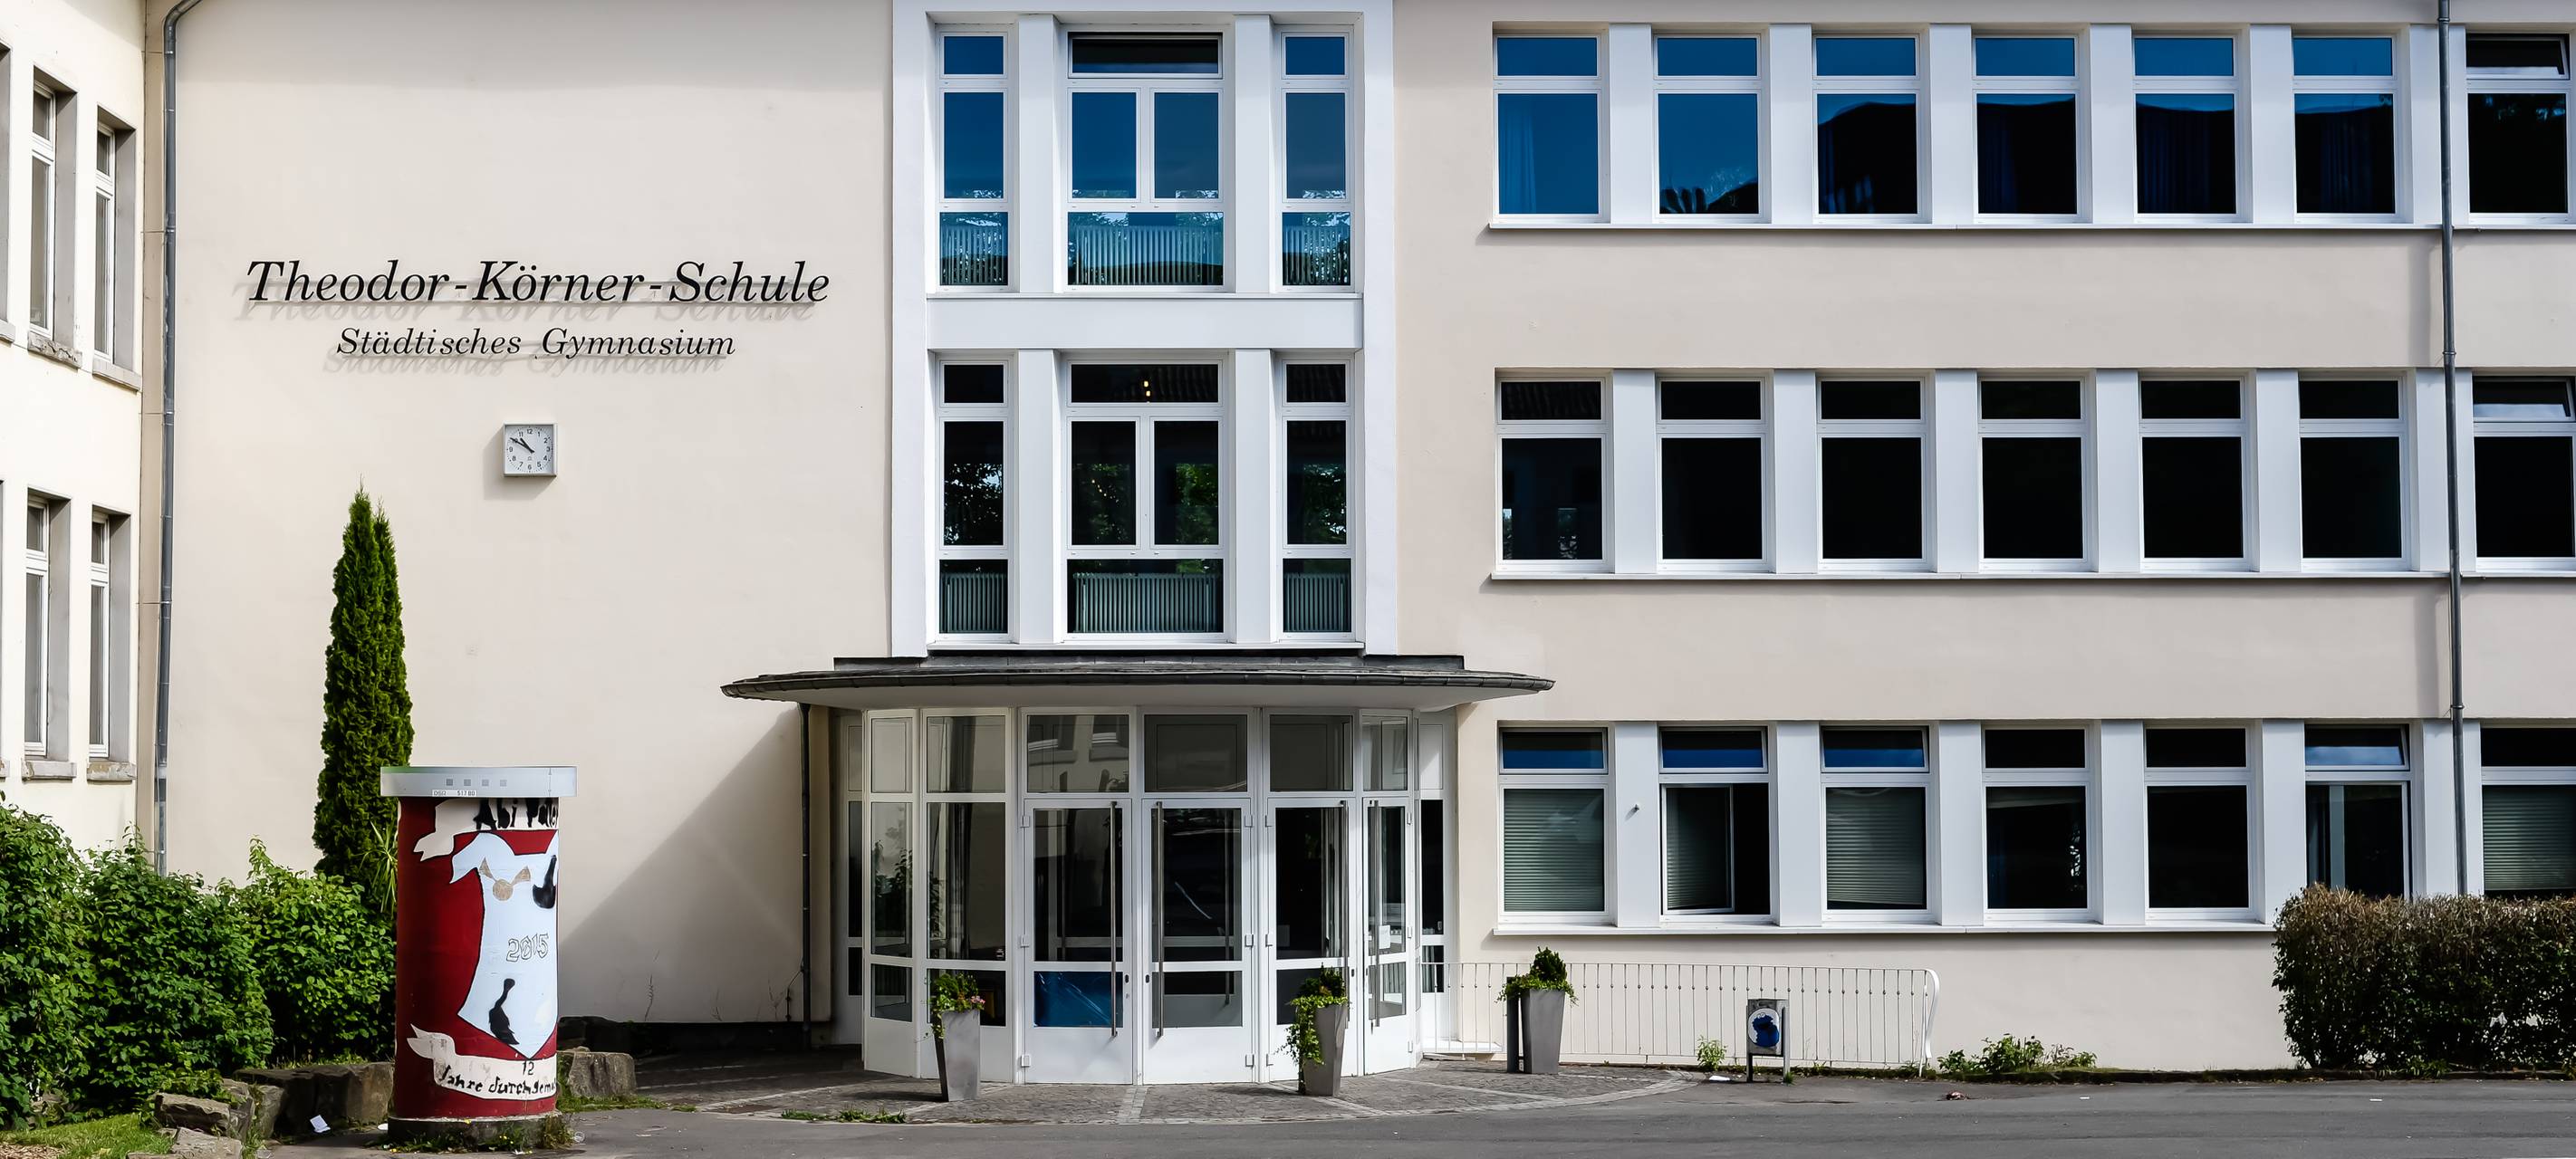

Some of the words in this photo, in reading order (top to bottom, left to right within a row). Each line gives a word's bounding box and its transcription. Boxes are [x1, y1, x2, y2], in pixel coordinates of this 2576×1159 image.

[247, 260, 830, 302] Theodor-Körner-Schule
[336, 327, 522, 356] Städtisches
[541, 327, 735, 360] Gymnasium
[505, 933, 550, 963] 2015
[523, 1060, 534, 1076] 12
